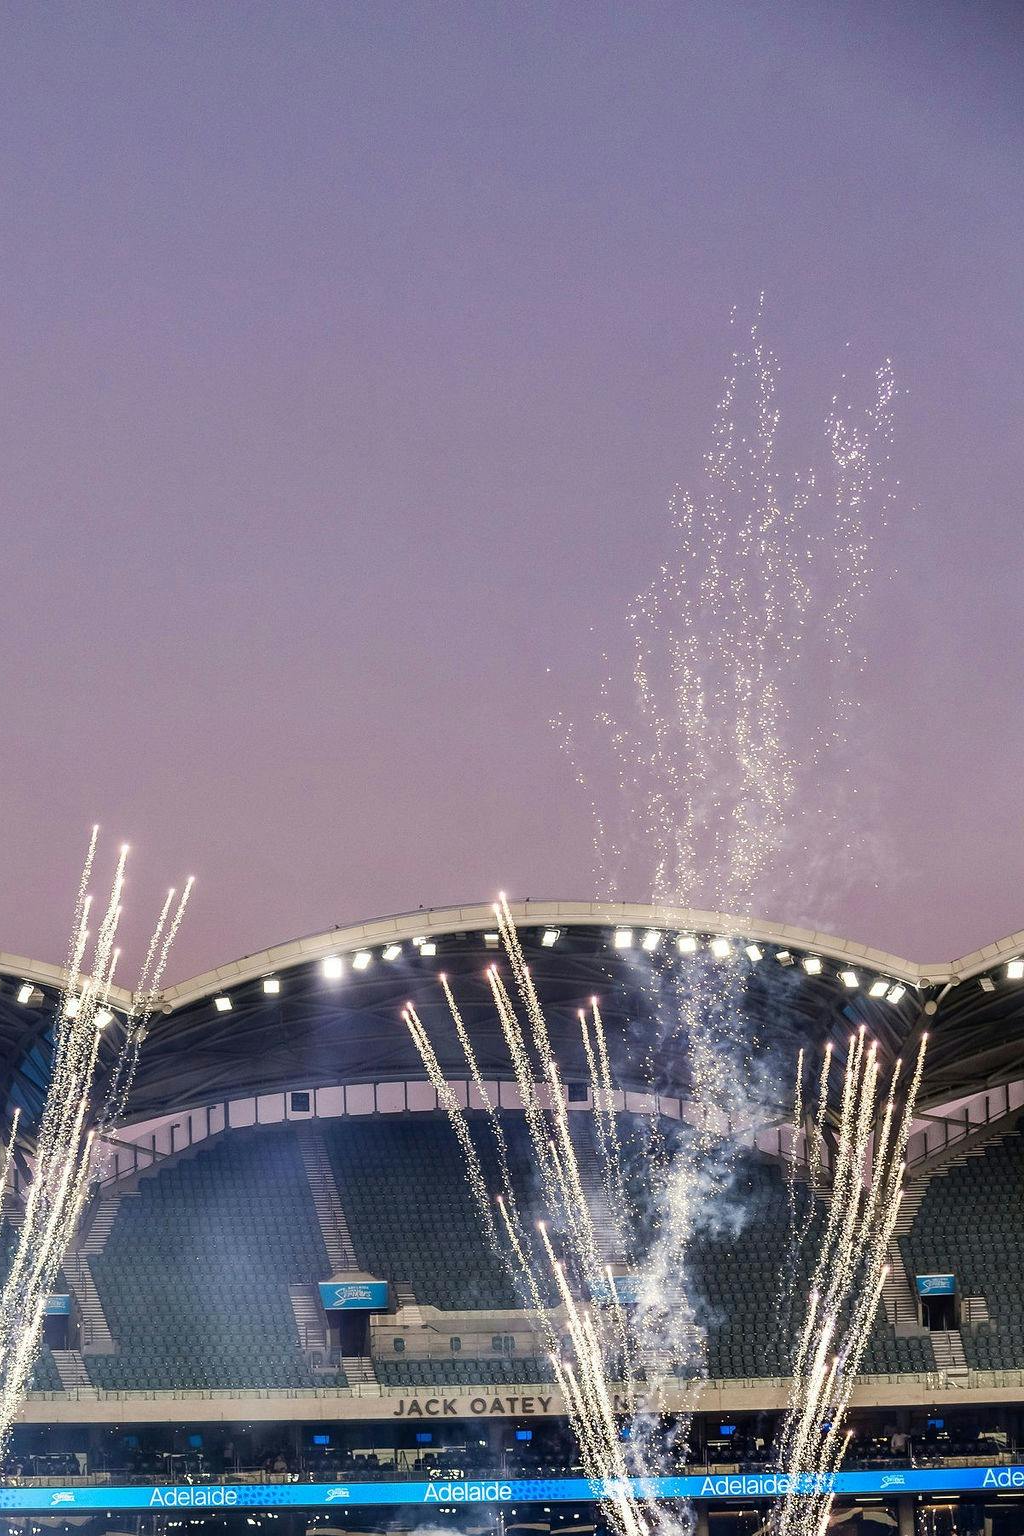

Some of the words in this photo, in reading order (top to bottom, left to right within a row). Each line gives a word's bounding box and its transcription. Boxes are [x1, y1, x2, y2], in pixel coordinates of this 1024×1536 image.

[394, 1398, 458, 1416] JACK
[470, 1396, 552, 1415] OATEY
[149, 1487, 237, 1506] Adelaide
[423, 1482, 512, 1502] Adelaide
[701, 1476, 789, 1495] Adelaide
